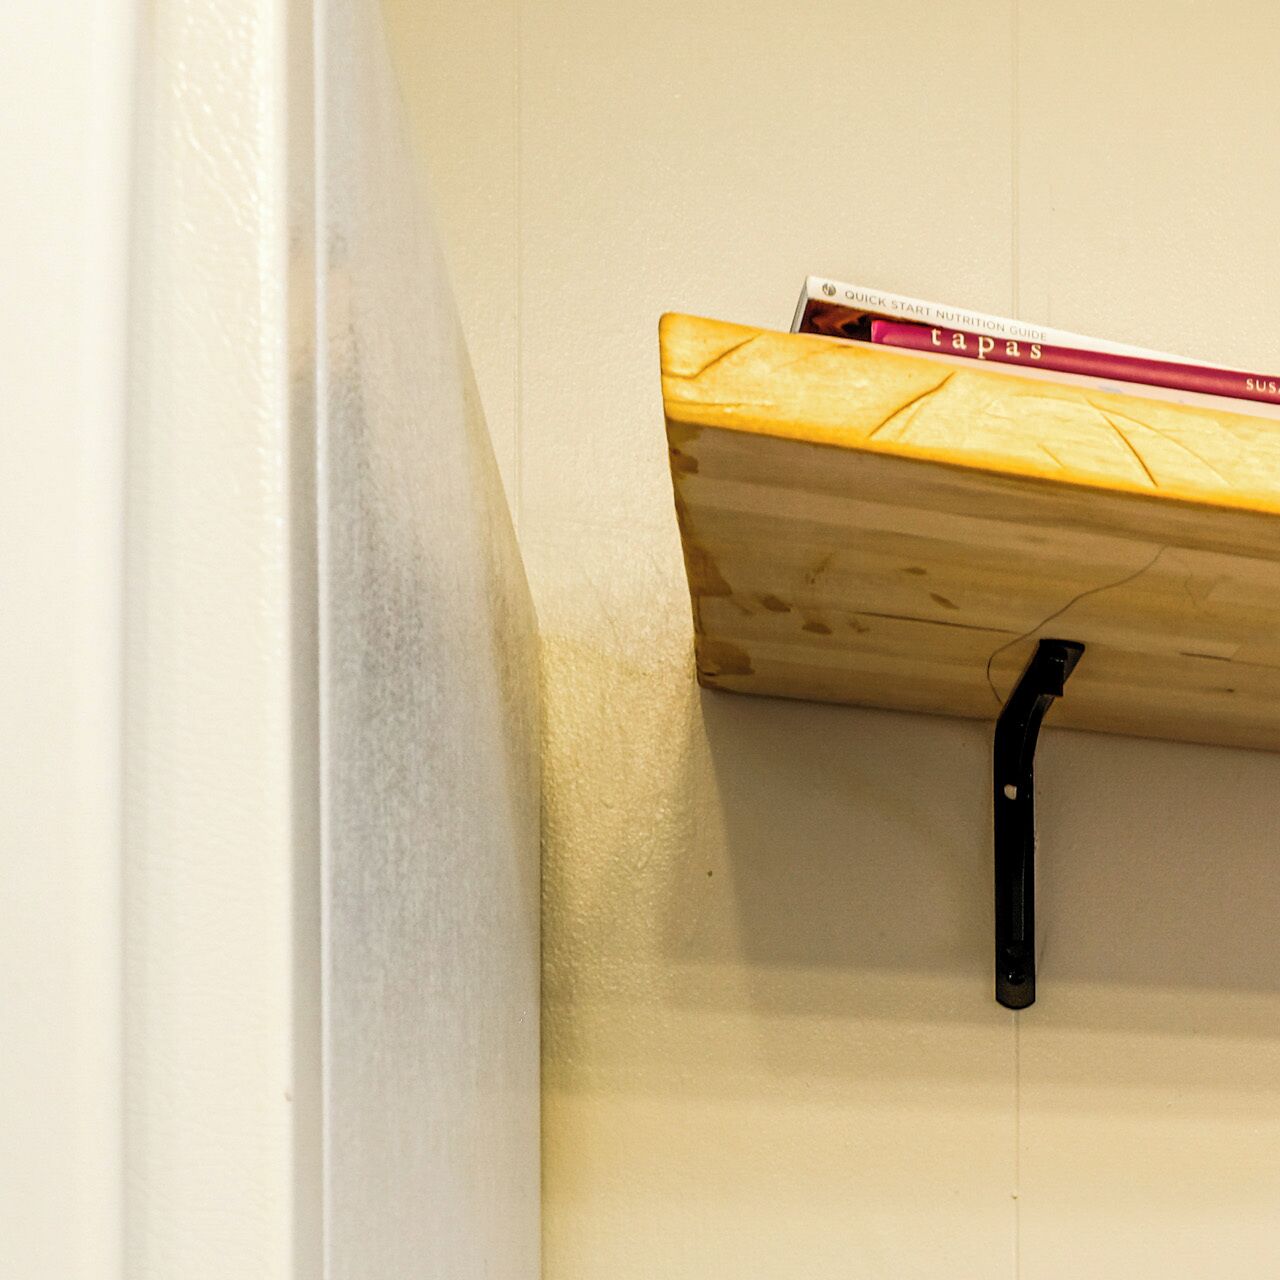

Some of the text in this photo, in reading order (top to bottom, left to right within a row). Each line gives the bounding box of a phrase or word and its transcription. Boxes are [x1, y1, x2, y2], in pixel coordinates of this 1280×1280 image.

[844, 289, 1048, 342] QUICK START NUTRITION GUIDE
[930, 328, 1042, 360] tapas
